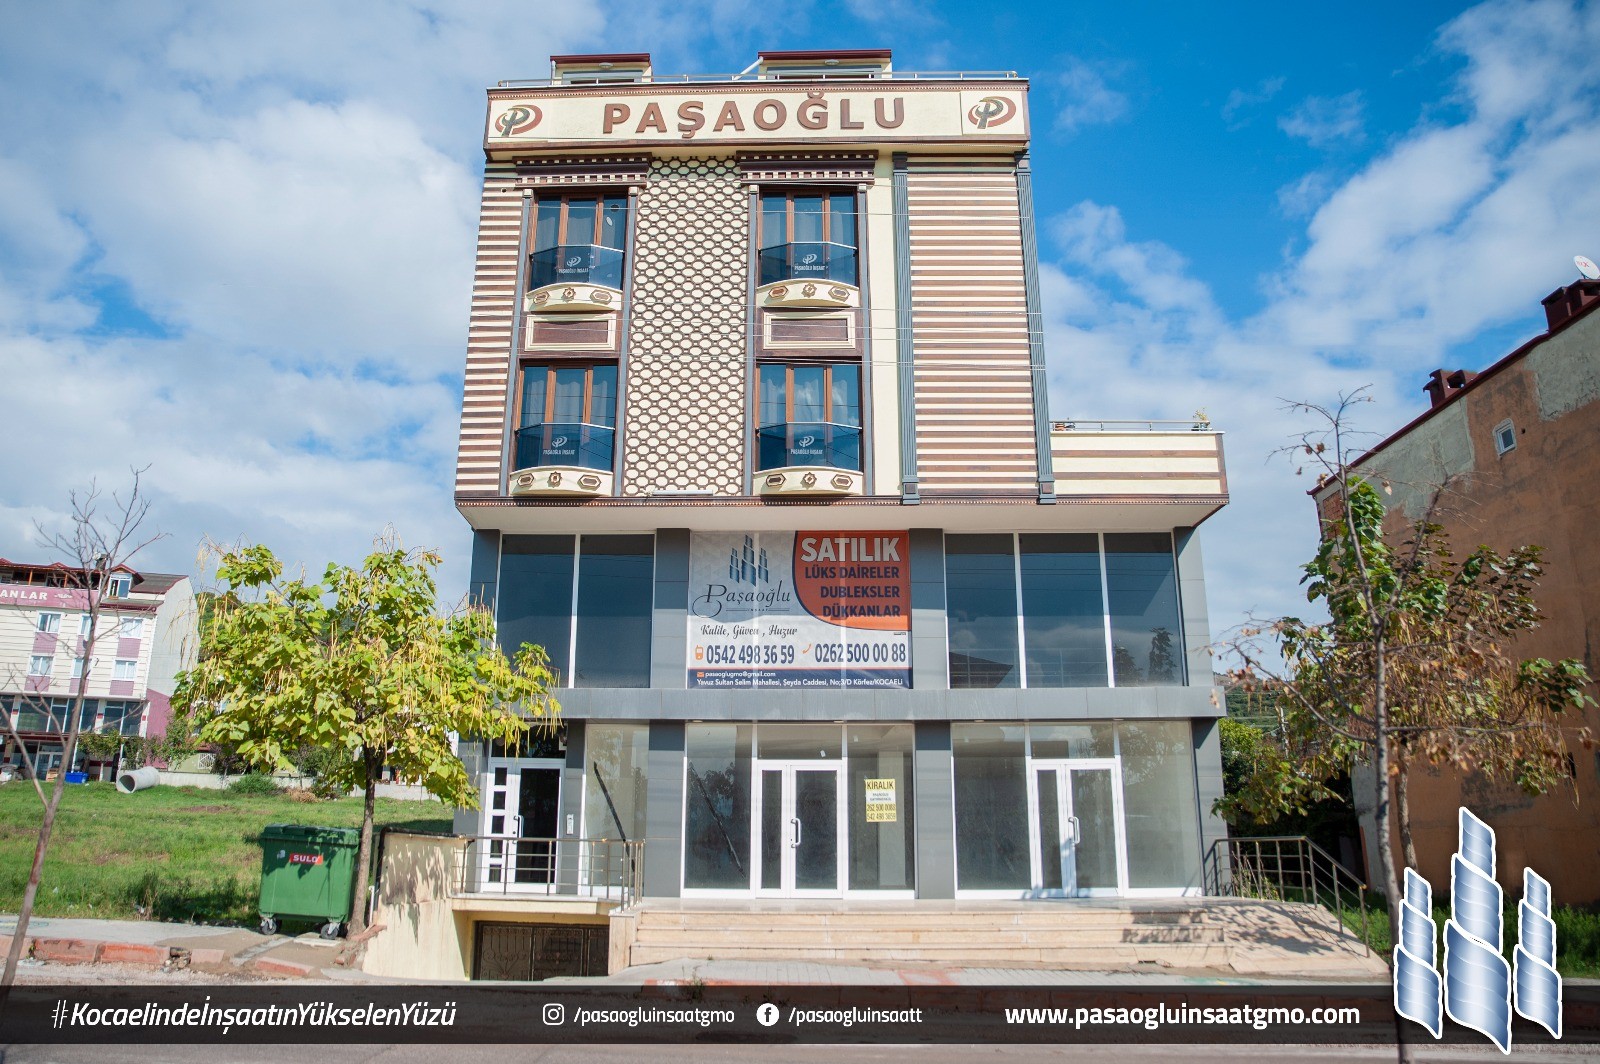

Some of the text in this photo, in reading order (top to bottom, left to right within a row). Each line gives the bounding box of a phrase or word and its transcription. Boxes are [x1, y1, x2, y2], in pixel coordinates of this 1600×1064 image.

[603, 90, 905, 139] PAŞAOĞLU
[800, 537, 901, 562] SATILIK
[805, 565, 900, 579] LÜKS DAİRELER
[692, 579, 791, 618] Paşaoğlu
[820, 586, 900, 598] DUBLEKSLER
[822, 604, 901, 618] DÜKKANLAR
[768, 624, 798, 639] Huzur
[706, 644, 795, 664] 0542 498 36 59
[814, 643, 906, 663] 0262 500 00 88
[803, 679, 829, 687] Caddesi,
[867, 781, 894, 790] KİRALIK
[293, 854, 318, 863] SULO
